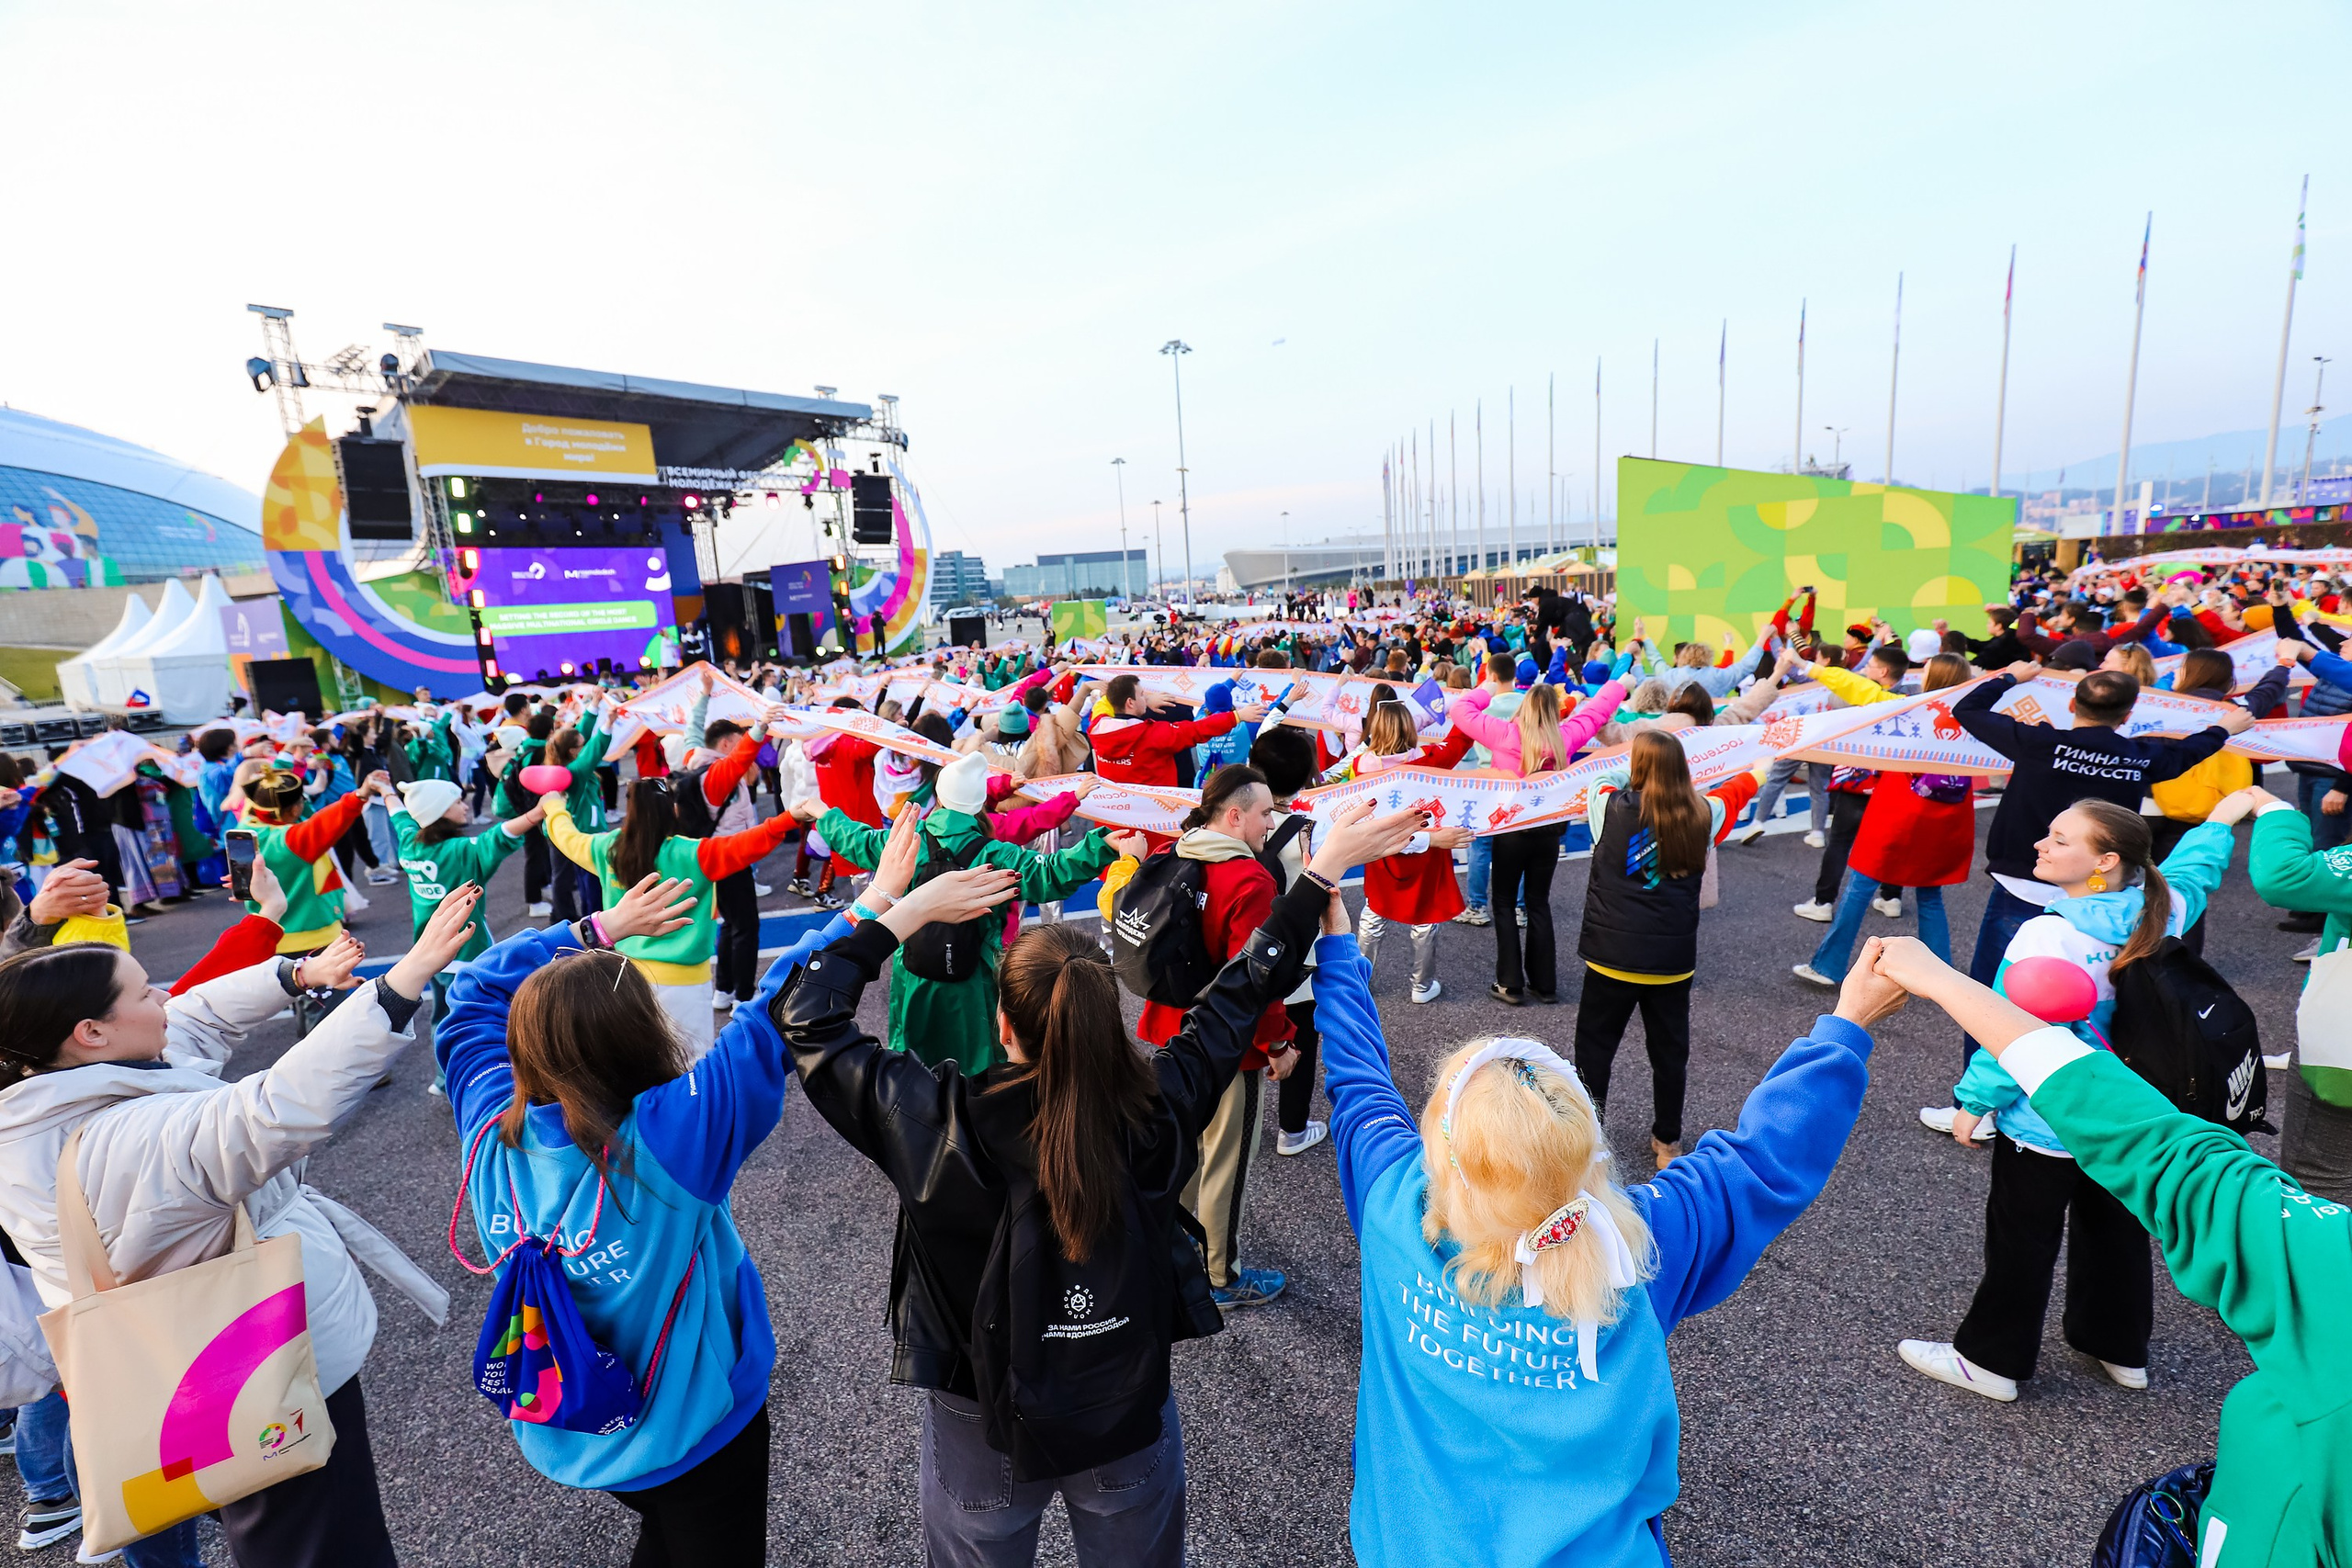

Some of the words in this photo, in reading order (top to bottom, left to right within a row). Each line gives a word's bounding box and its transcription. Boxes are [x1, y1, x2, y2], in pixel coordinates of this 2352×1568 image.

[666, 466, 737, 479] ВСЕМИРНЫЙ
[669, 478, 734, 491] МОЛОДЁЖИ
[2053, 744, 2151, 769] ГИМНАЗИЯ
[2052, 757, 2142, 782] ИСКУССТВ
[2227, 1048, 2253, 1102] NIKE
[1082, 1316, 1117, 1330] РОССИЯ
[1397, 1280, 1451, 1334] THE
[1462, 1322, 1581, 1371] FUTUR
[1406, 1316, 1577, 1390] TOGETHER
